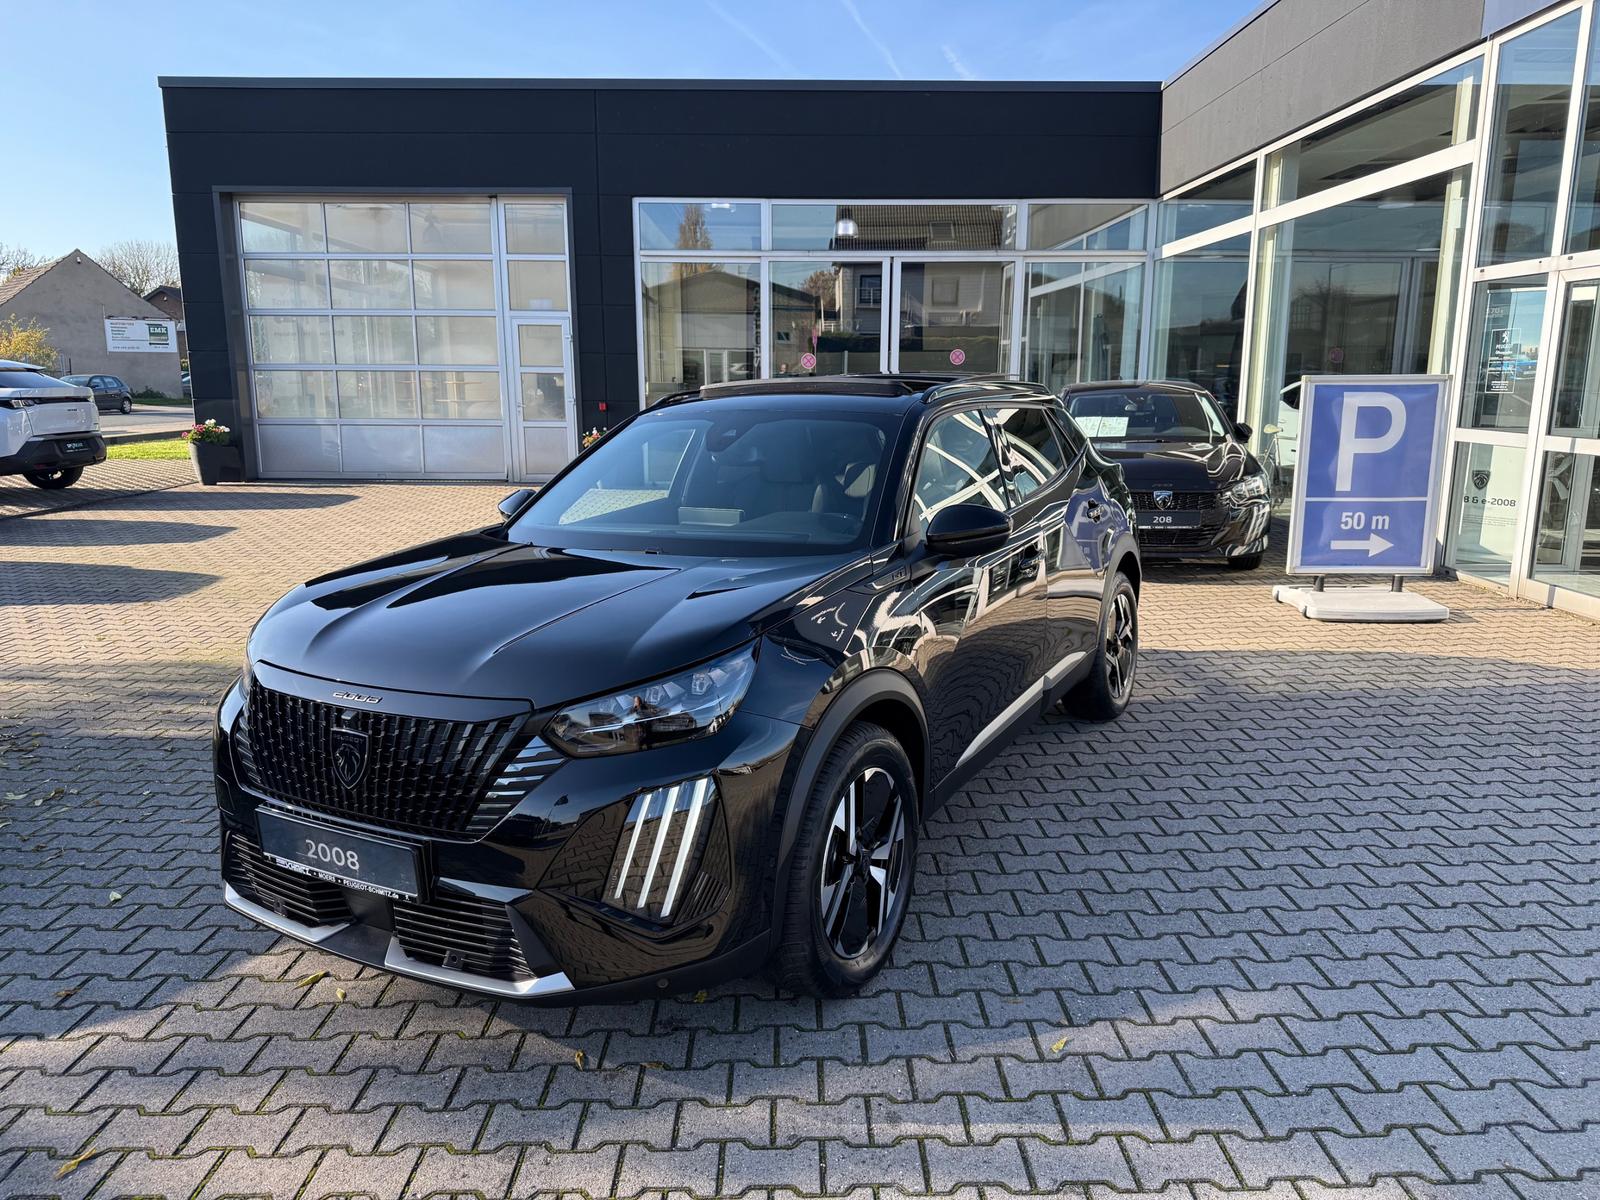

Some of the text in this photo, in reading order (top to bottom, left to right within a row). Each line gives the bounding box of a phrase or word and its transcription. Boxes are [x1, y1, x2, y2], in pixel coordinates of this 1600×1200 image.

[1335, 391, 1407, 492] P
[1471, 496, 1479, 504] &
[1481, 497, 1517, 507] e-2008
[1152, 516, 1173, 524] 208
[1340, 511, 1390, 530] 50 m
[305, 839, 360, 870] 2008
